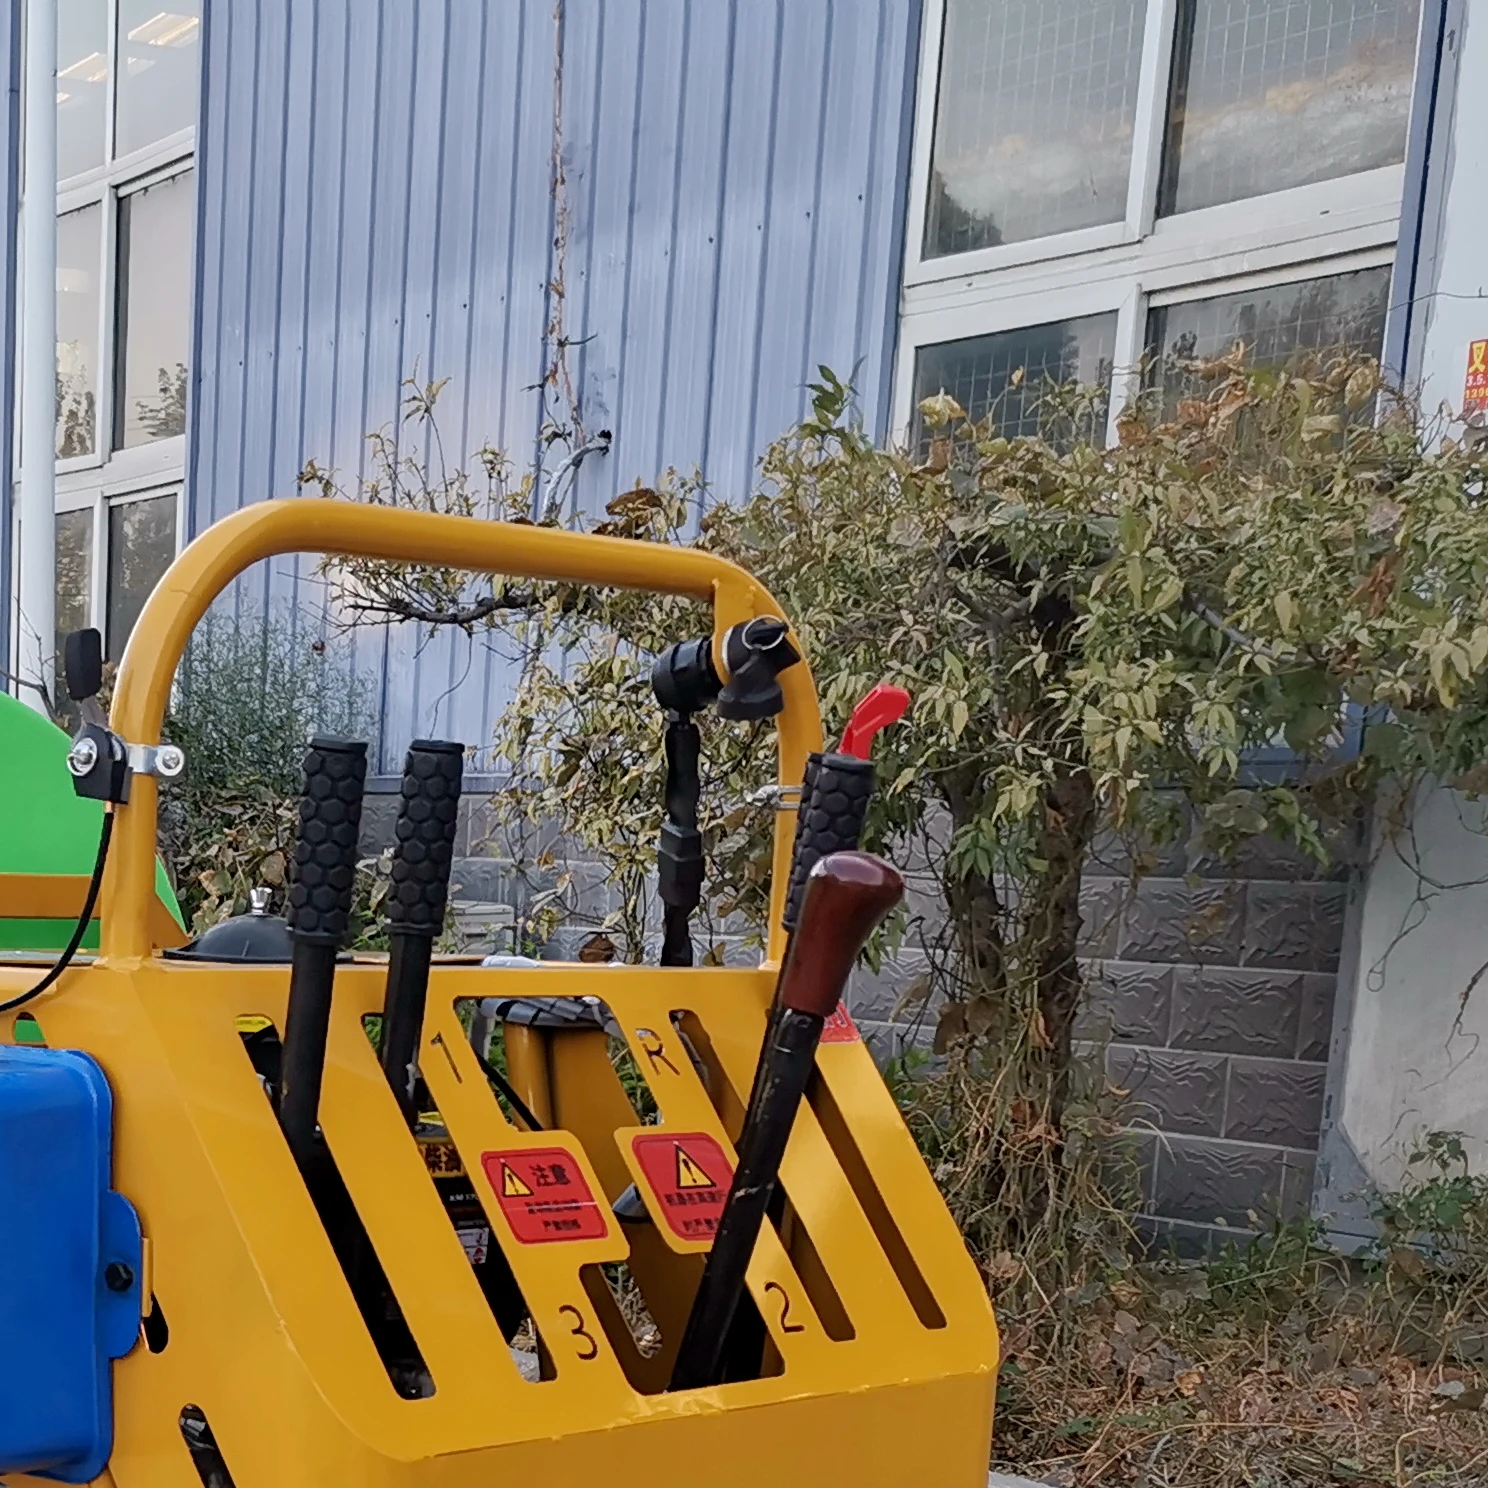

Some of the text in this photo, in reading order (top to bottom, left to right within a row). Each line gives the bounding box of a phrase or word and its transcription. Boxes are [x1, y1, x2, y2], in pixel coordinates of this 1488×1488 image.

[430, 1031, 463, 1084] 1
[635, 1027, 680, 1076] R
[528, 1163, 571, 1187] 注意
[558, 1304, 598, 1360] 3
[764, 1281, 805, 1333] 2
